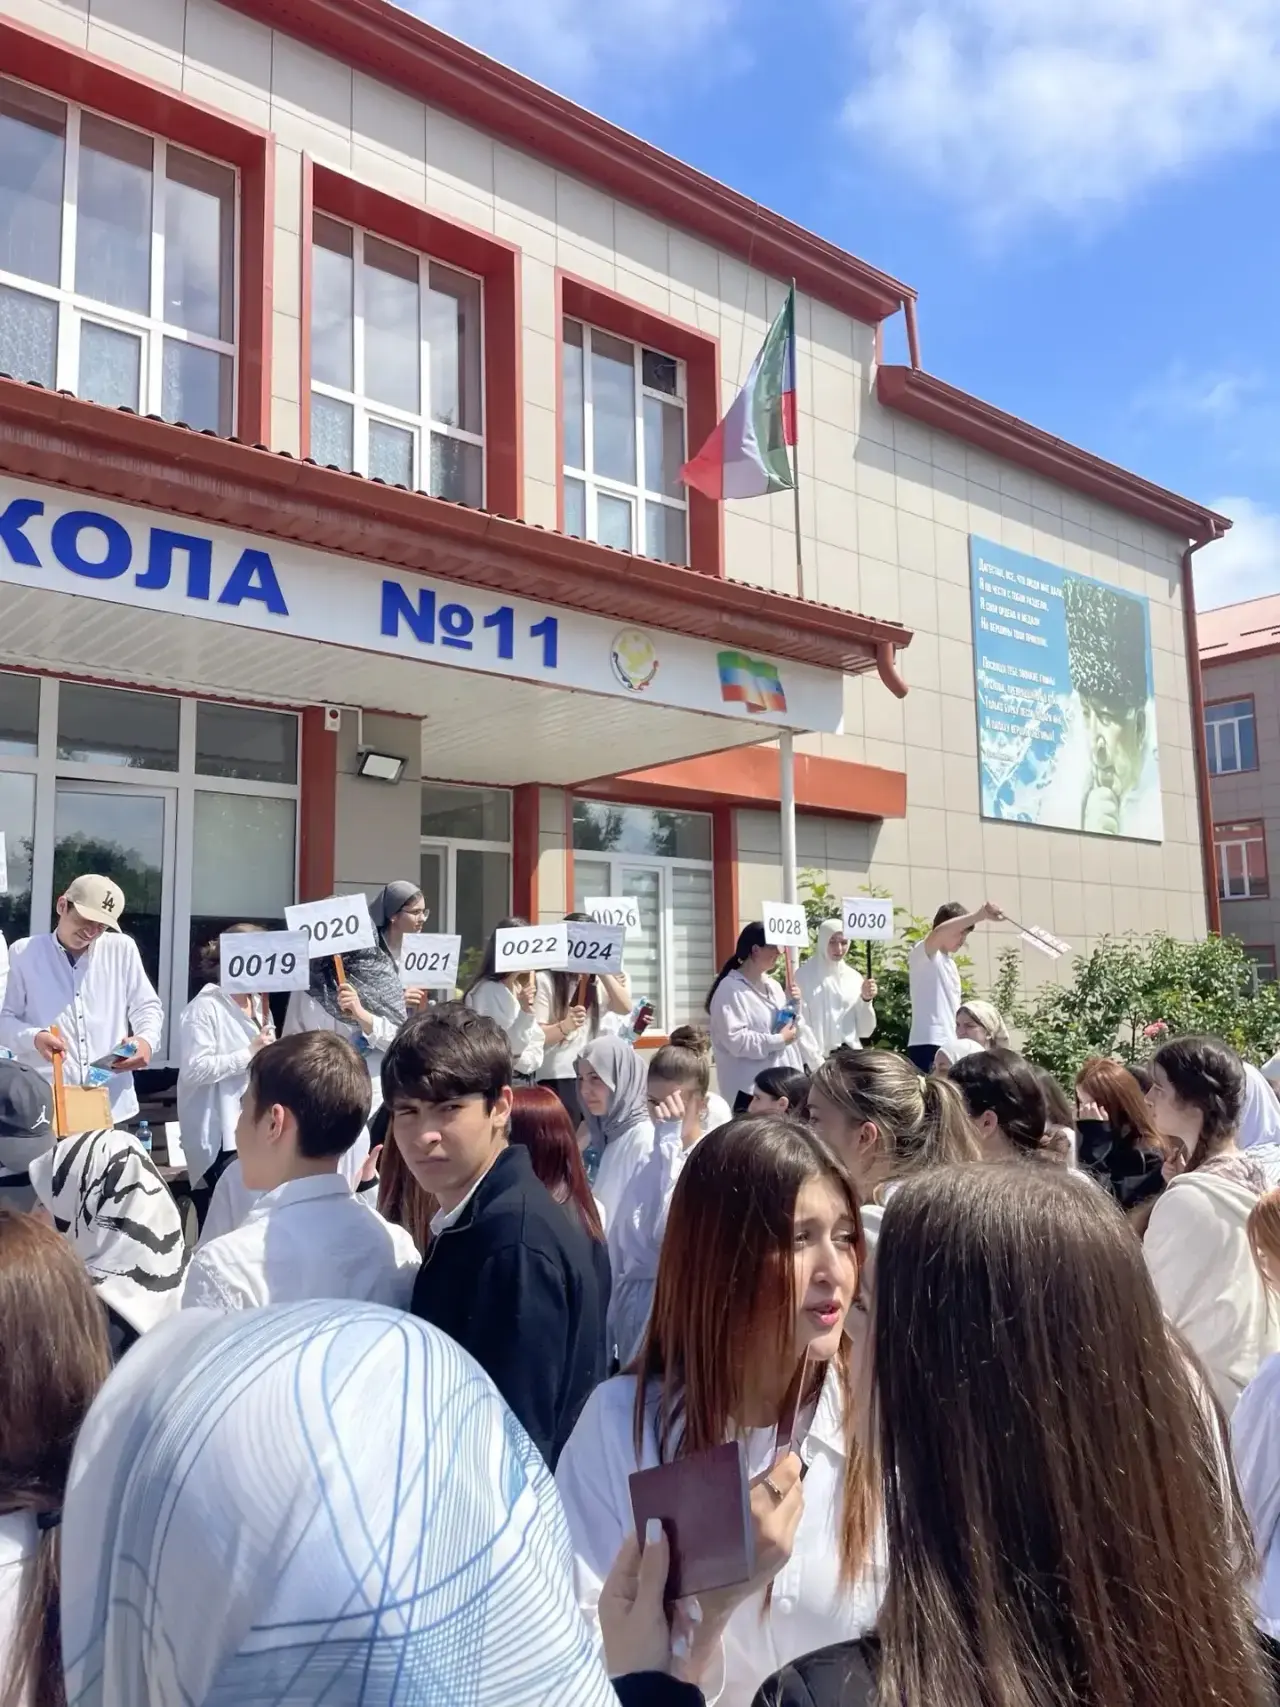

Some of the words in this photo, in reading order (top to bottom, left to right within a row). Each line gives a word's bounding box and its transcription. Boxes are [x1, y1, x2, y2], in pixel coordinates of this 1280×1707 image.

[380, 579, 558, 669] №11
[101, 890, 116, 913] LA
[591, 908, 637, 927] 0026
[768, 917, 802, 935] 0028
[848, 912, 886, 929] 0030
[502, 937, 558, 956] 0022
[228, 952, 297, 978] 0019
[404, 951, 451, 972] 0021
